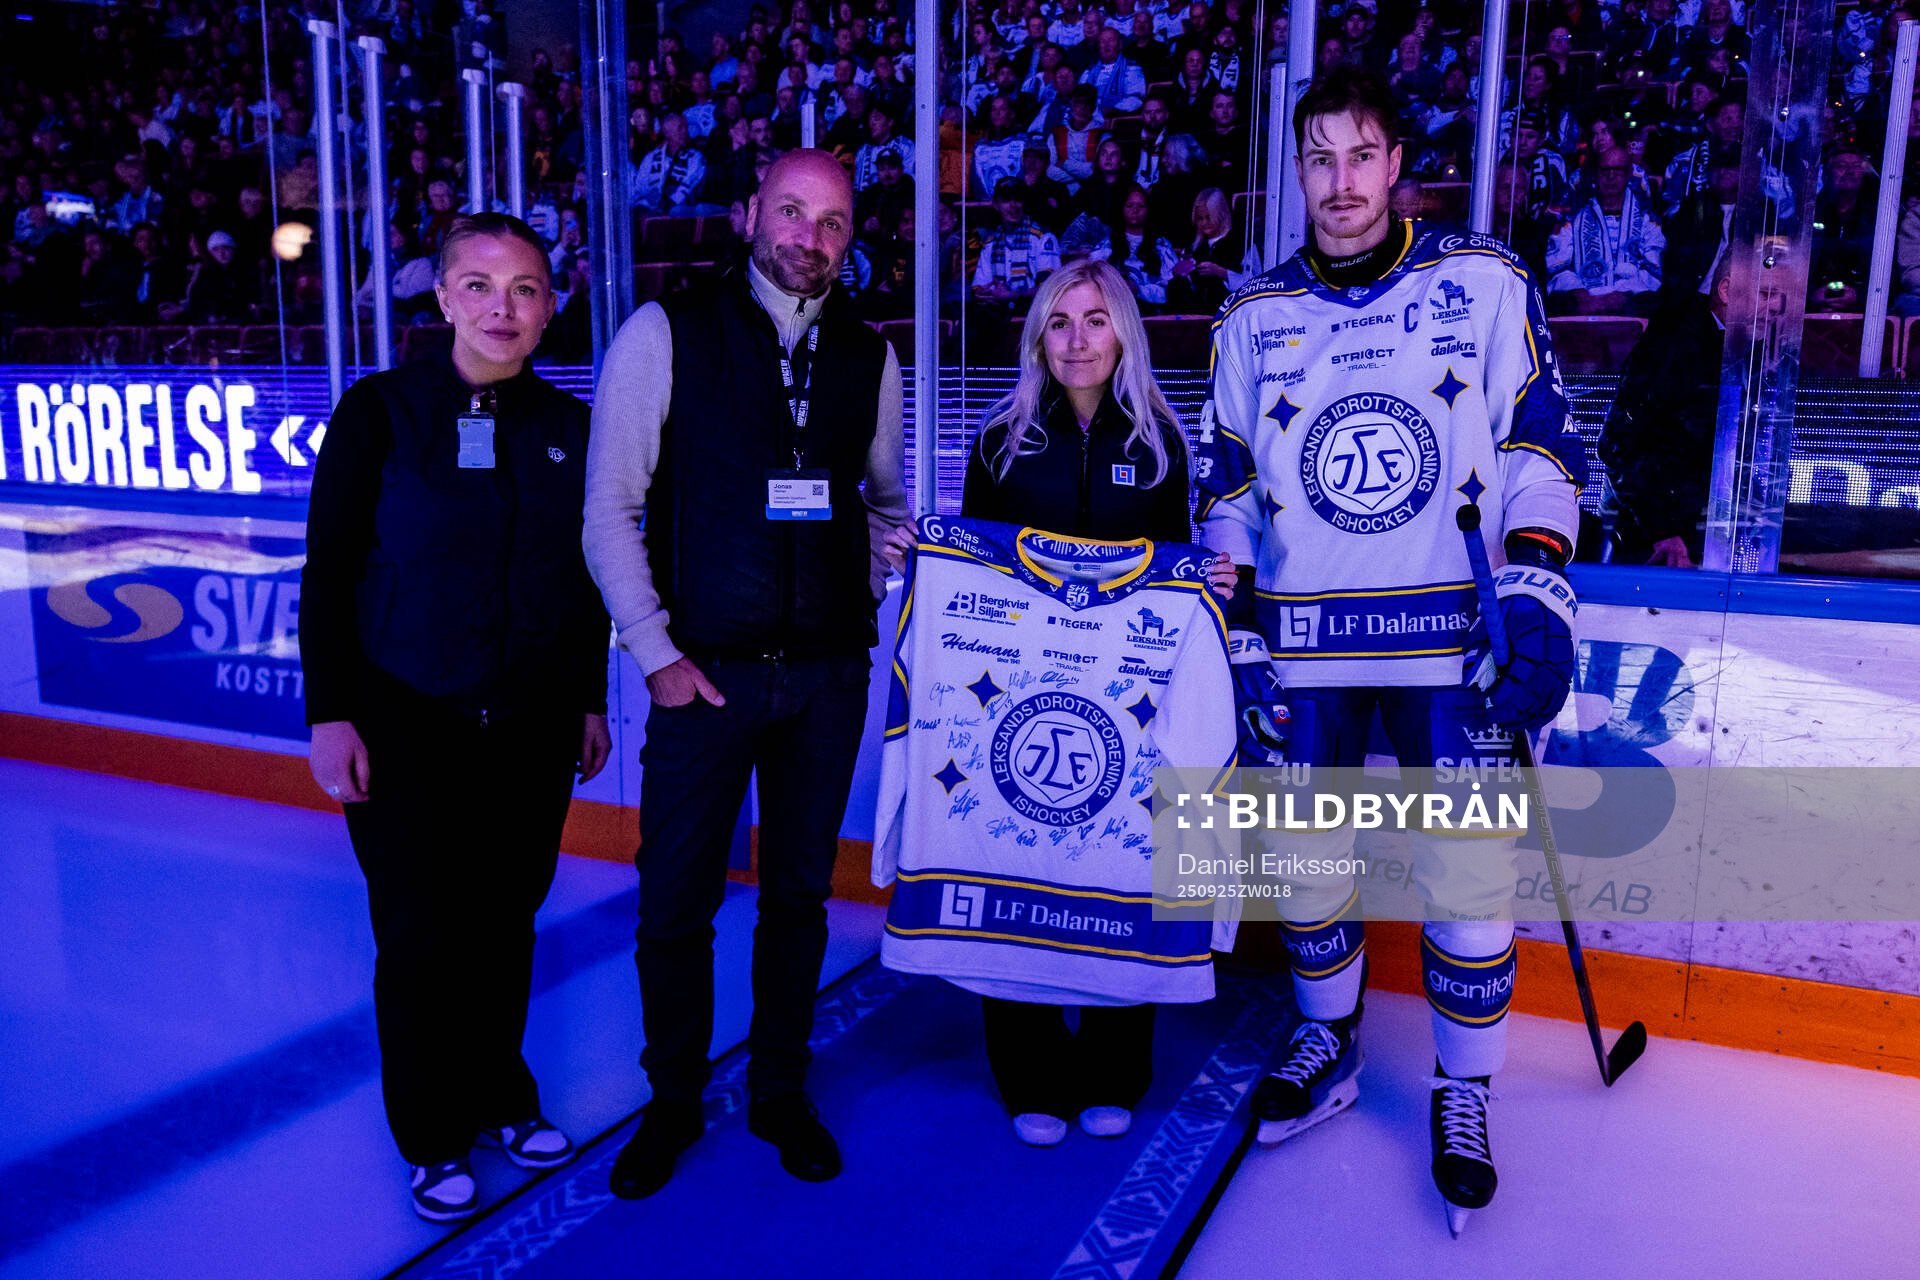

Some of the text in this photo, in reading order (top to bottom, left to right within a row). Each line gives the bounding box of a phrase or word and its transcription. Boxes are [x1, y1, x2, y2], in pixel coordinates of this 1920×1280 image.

[1469, 238, 1519, 263] Ohlson
[1343, 314, 1395, 330] TEGERA
[1404, 302, 1418, 333] C
[1432, 308, 1469, 321] LEKSAN
[1431, 340, 1476, 357] dalakra
[1199, 399, 1216, 443] 4
[16, 383, 262, 493] RÖRELSE
[1302, 395, 1438, 506] LEKSANDS IDROTTSFÖRENING
[1332, 501, 1415, 532] ISHOCKEY
[948, 536, 994, 558] Ohlson
[950, 526, 979, 544] Clas
[979, 594, 1030, 611] Bergkvist
[1066, 592, 1089, 607] 50
[1493, 571, 1578, 618] AUER
[978, 605, 1007, 619] Siljan
[1059, 618, 1102, 631] TEGERA
[1328, 612, 1470, 636] LF Dalarnas
[941, 632, 1021, 658] Hedmans
[1126, 634, 1177, 648] LEKSANDS
[1056, 662, 1084, 672] TRAVEL
[994, 695, 1121, 798] LEKSANDS IDROTTSFÖRENING
[1435, 757, 1526, 783] SAFE4
[1012, 796, 1091, 825] ISHOCKEY
[1588, 880, 1652, 916] AB
[993, 899, 1135, 937] LF Dalarnas
